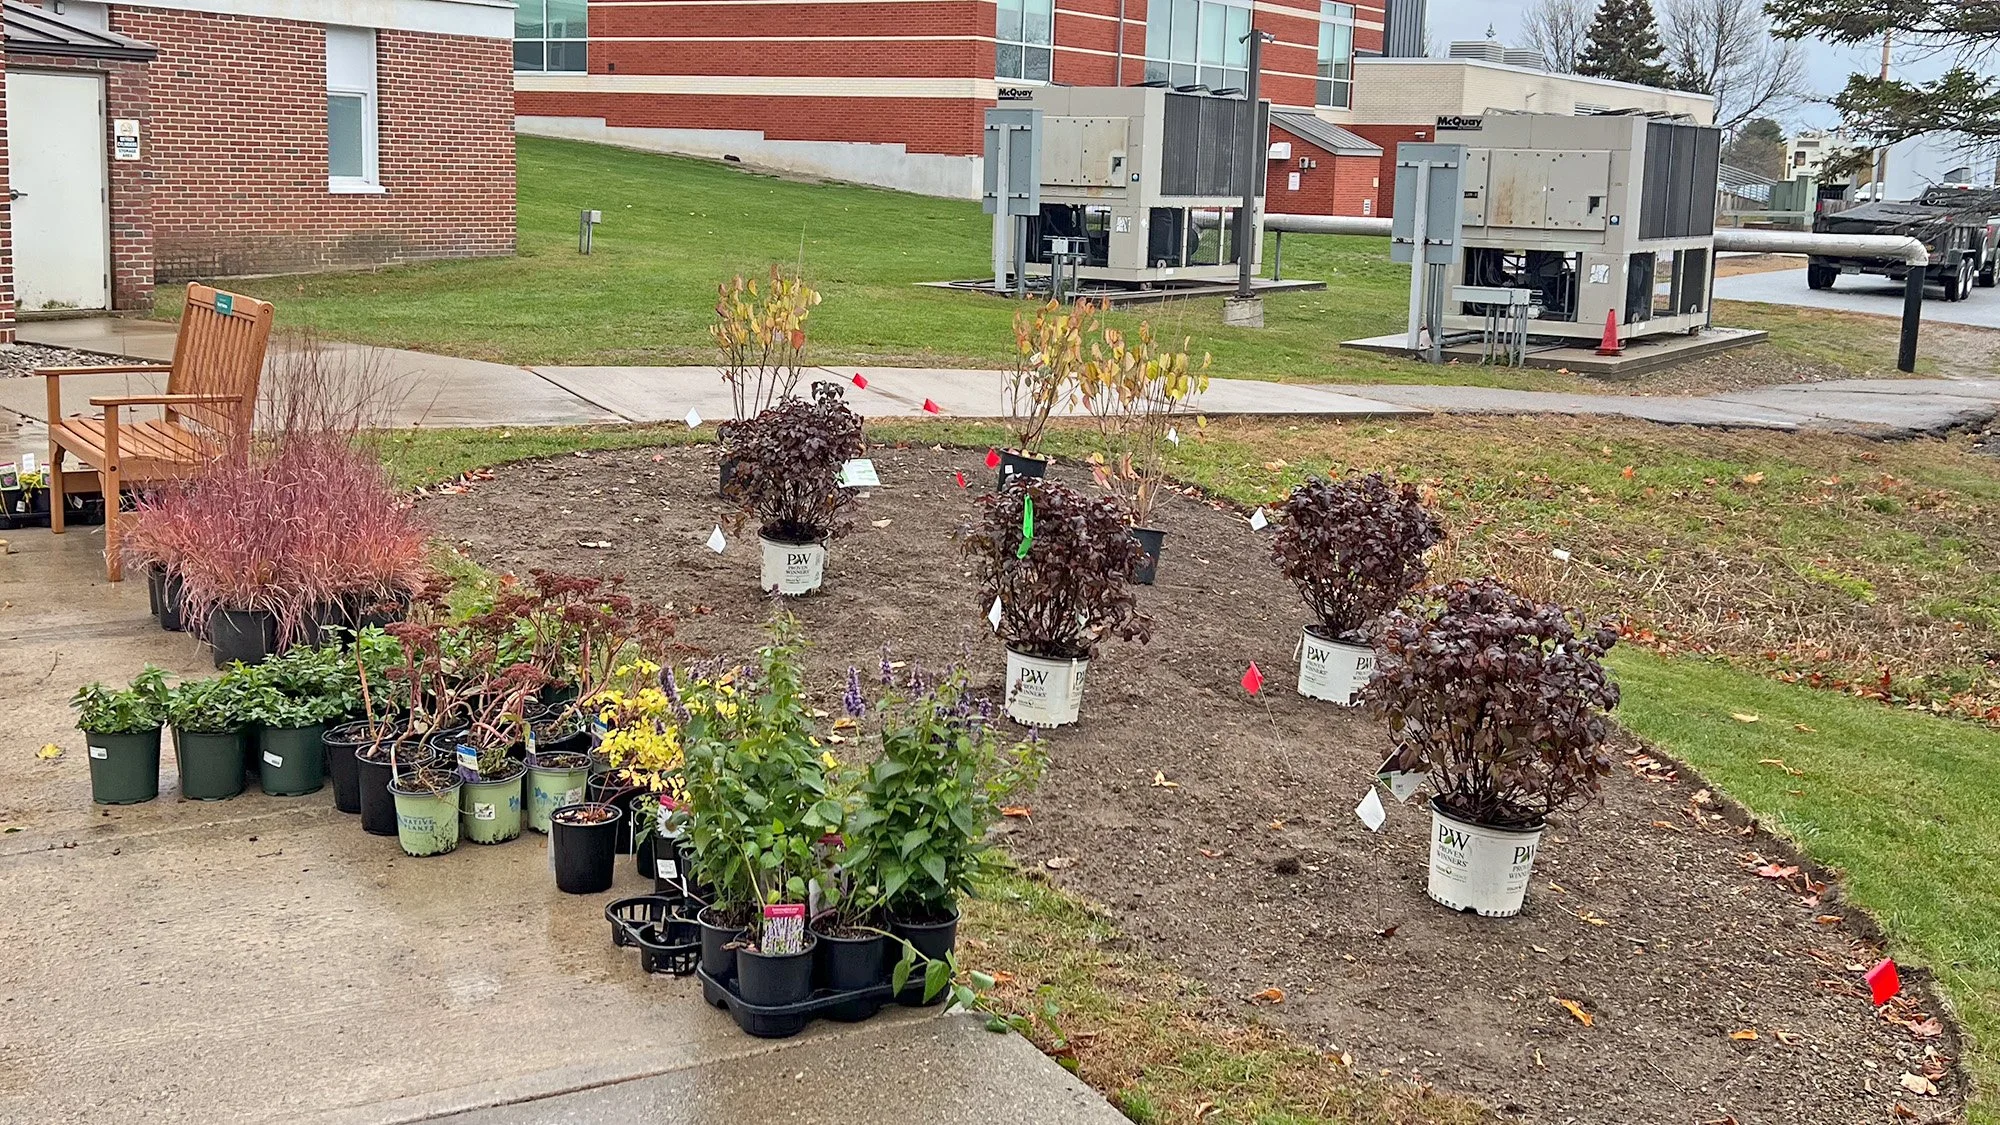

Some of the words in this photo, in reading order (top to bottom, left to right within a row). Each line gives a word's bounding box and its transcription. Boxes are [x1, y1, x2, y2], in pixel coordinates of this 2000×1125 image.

[998, 88, 1033, 97] McQuay
[1436, 116, 1482, 127] McQuay
[1022, 683, 1045, 691] ROVEN
[1022, 689, 1047, 697] INNERS
[1438, 823, 1471, 851] PW
[1438, 844, 1465, 859] PROVEN
[1437, 850, 1468, 867] WINNERS
